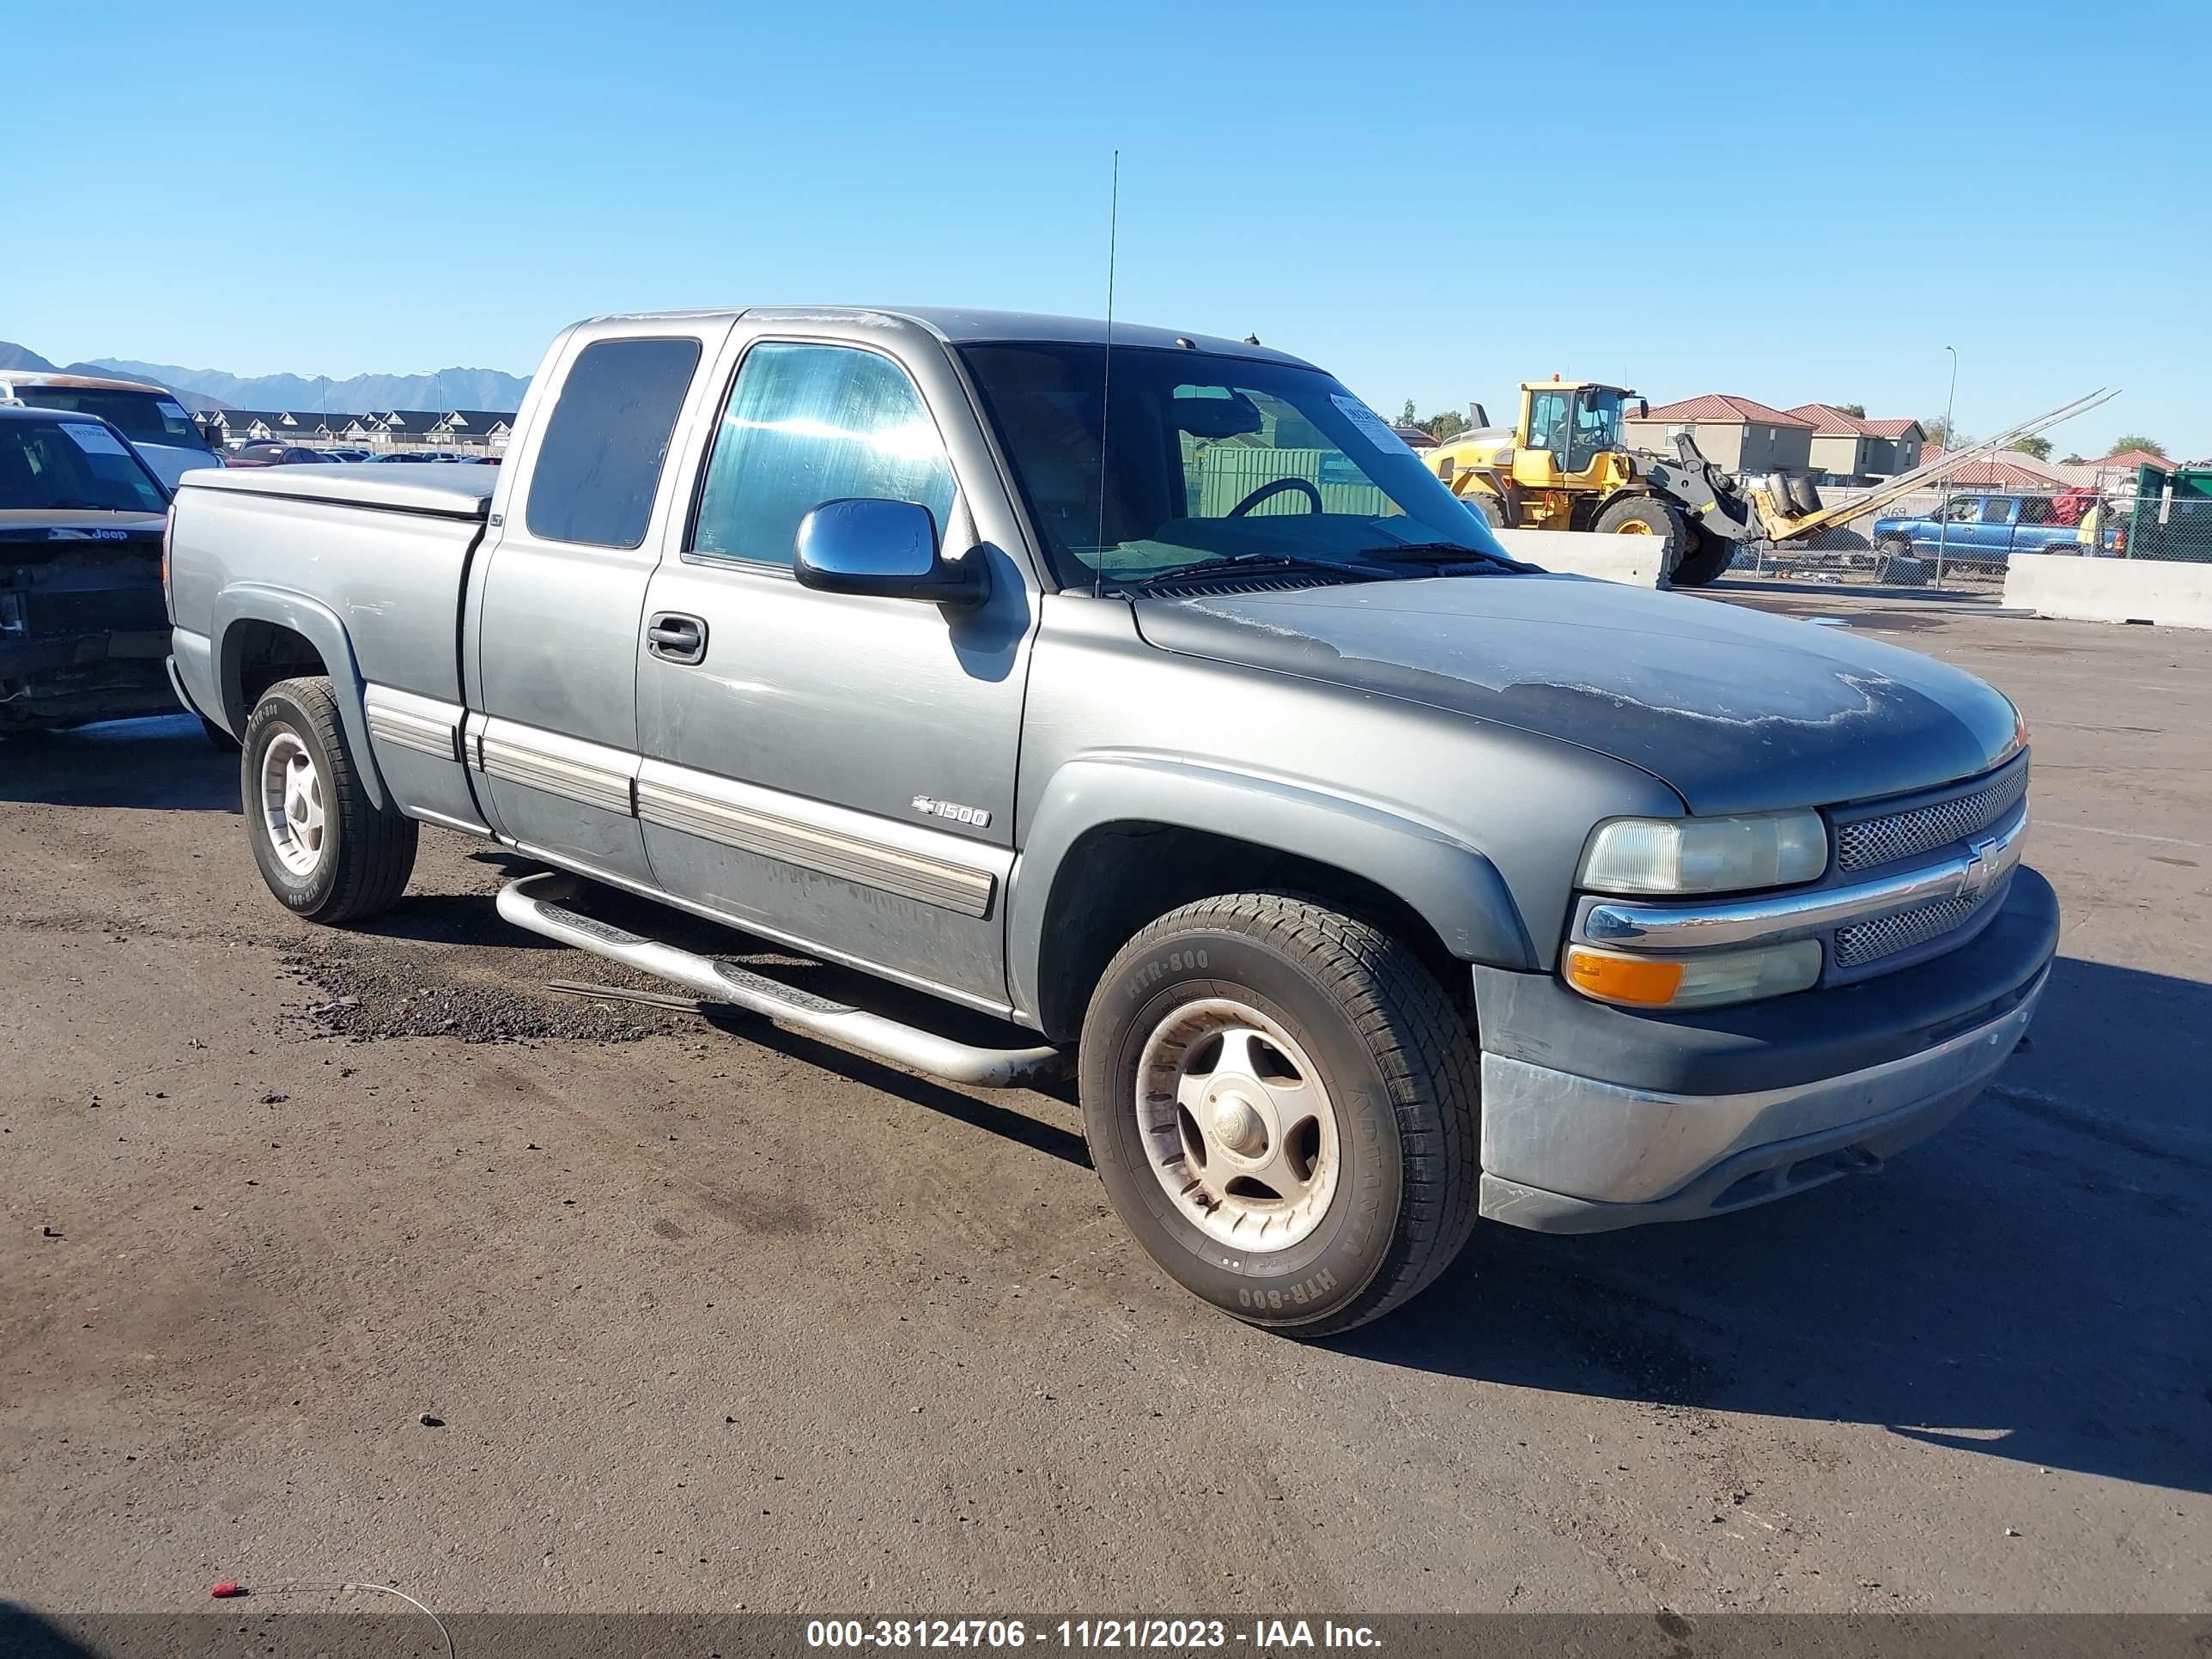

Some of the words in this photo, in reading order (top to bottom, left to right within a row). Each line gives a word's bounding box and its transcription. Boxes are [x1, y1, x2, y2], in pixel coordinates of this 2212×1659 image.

[92, 528, 128, 541] Jeep
[934, 800, 991, 828] 1500
[1126, 949, 1209, 1000] HTR-800
[1238, 1266, 1339, 1310] HTR-800
